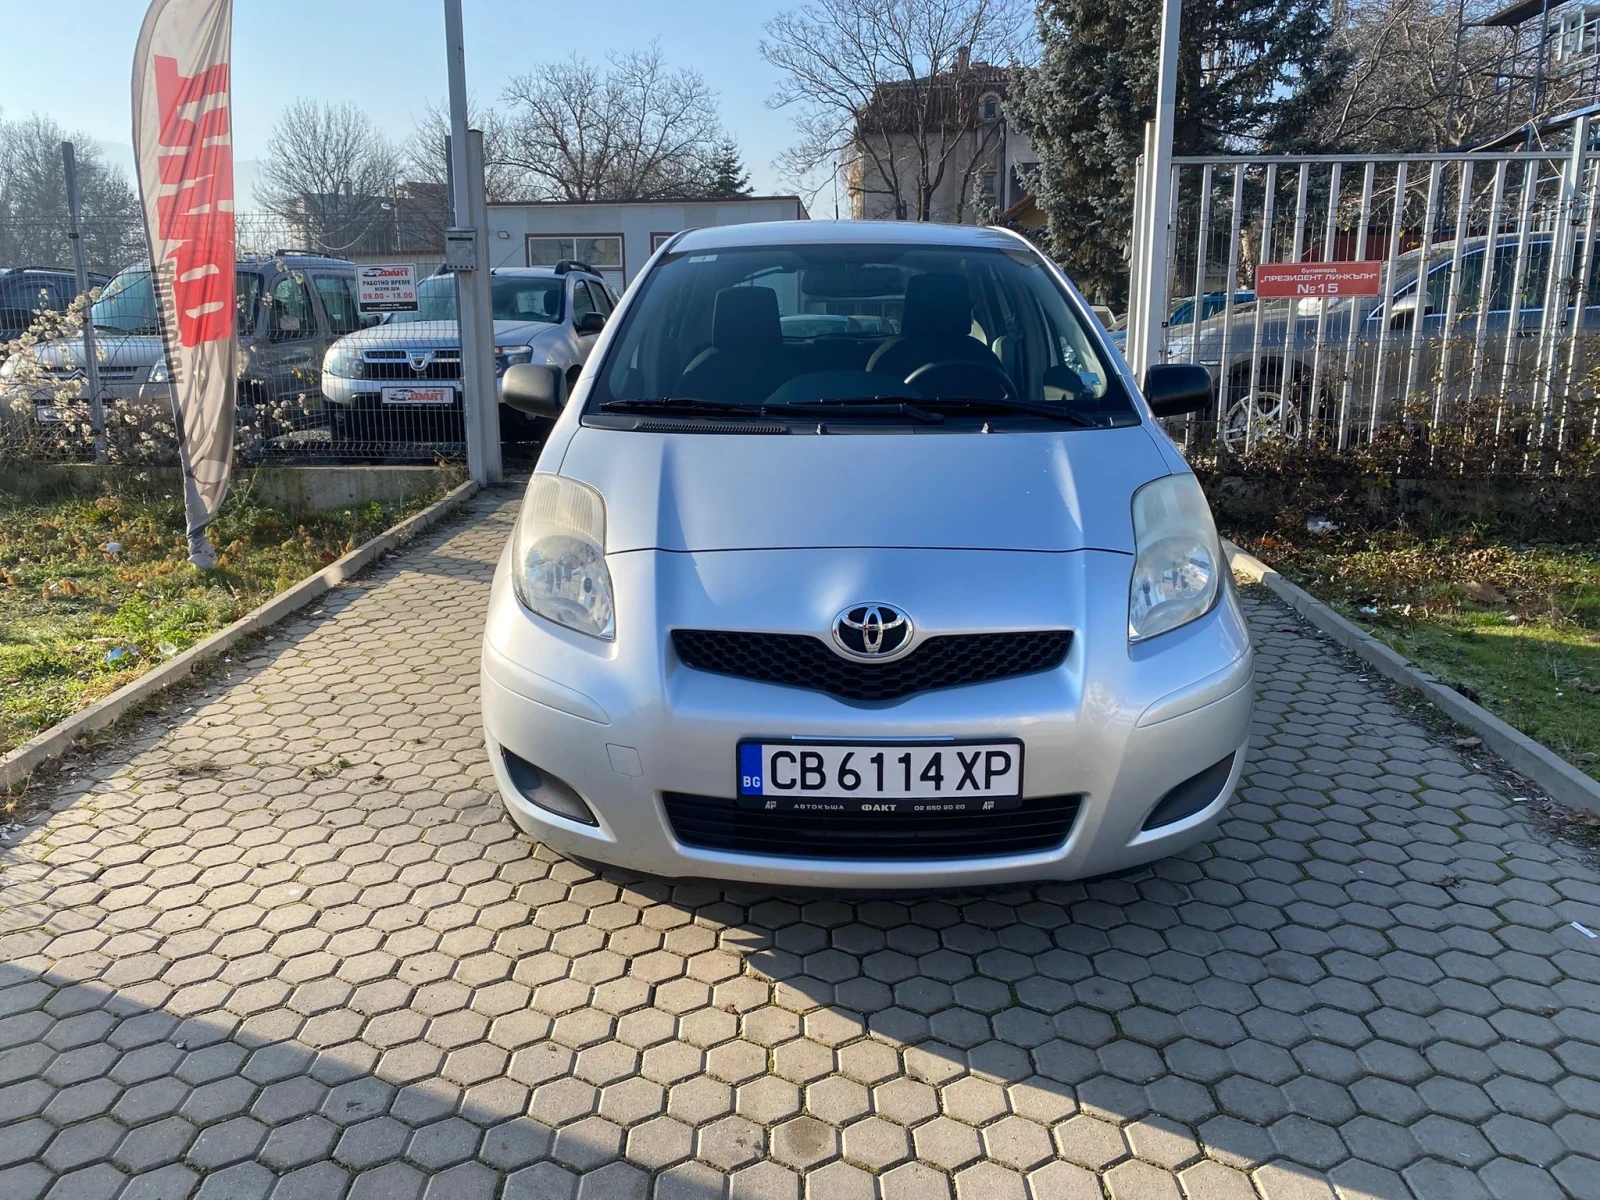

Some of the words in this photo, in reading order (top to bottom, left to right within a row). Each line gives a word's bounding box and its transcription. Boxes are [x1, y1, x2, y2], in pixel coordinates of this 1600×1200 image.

[154, 55, 233, 348] ФАКТ
[743, 776, 761, 788] BG
[770, 751, 827, 790] CB
[837, 752, 944, 792] 6114
[955, 751, 1012, 791] XP
[861, 804, 897, 812] ФАКТ
